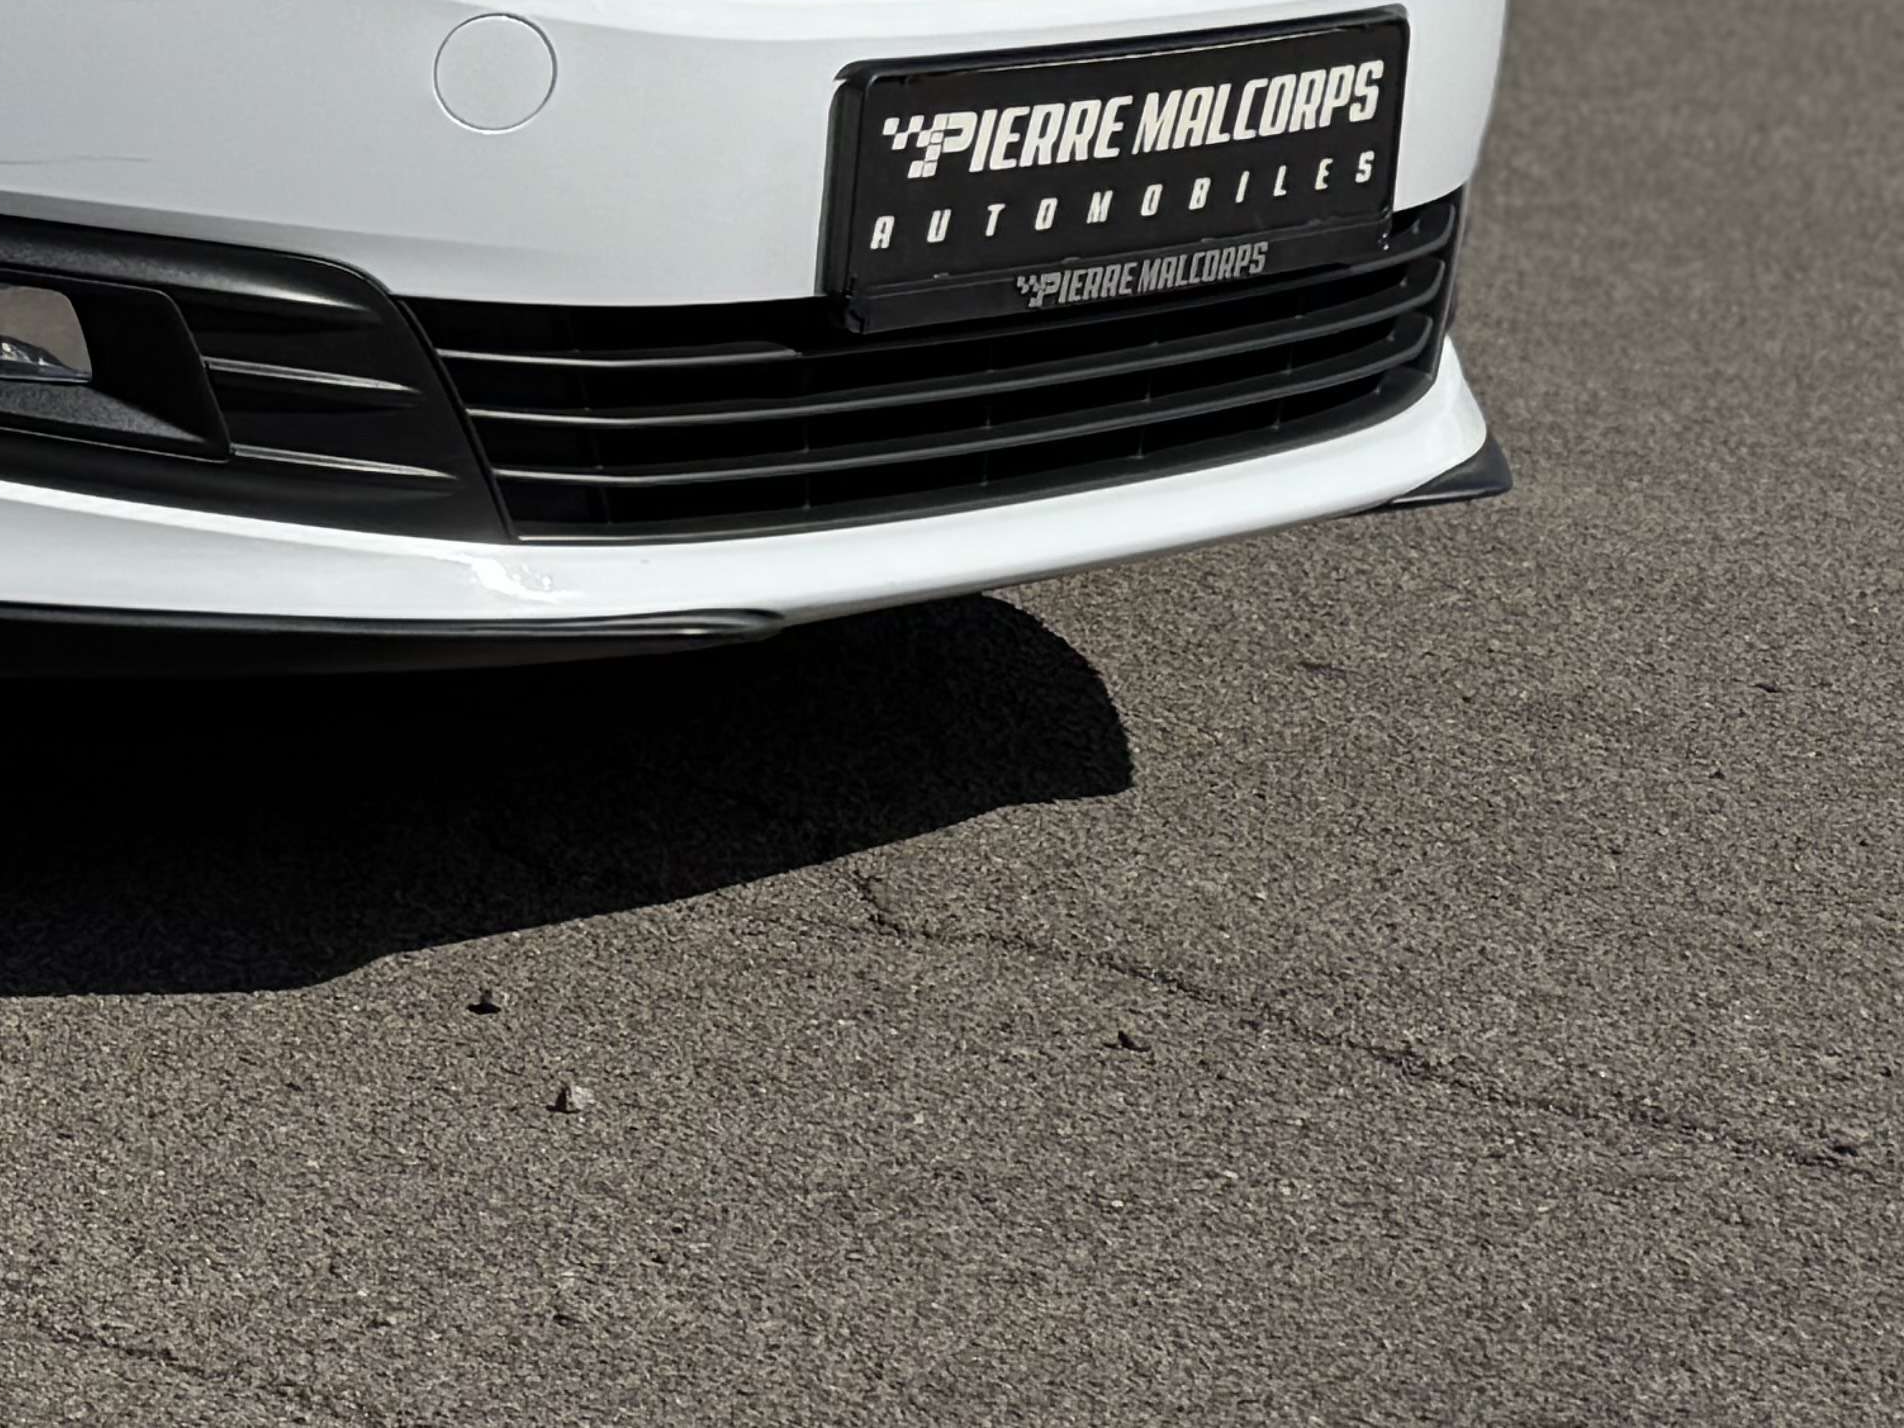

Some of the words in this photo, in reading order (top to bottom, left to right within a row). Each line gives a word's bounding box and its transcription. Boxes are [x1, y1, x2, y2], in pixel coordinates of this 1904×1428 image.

[882, 95, 1133, 179] PIERRE
[1131, 60, 1384, 155] MALCORPS
[870, 150, 1375, 250] AUTOMOBILES
[1017, 262, 1138, 308] PIERRE
[1137, 241, 1269, 293] MALCORPS
